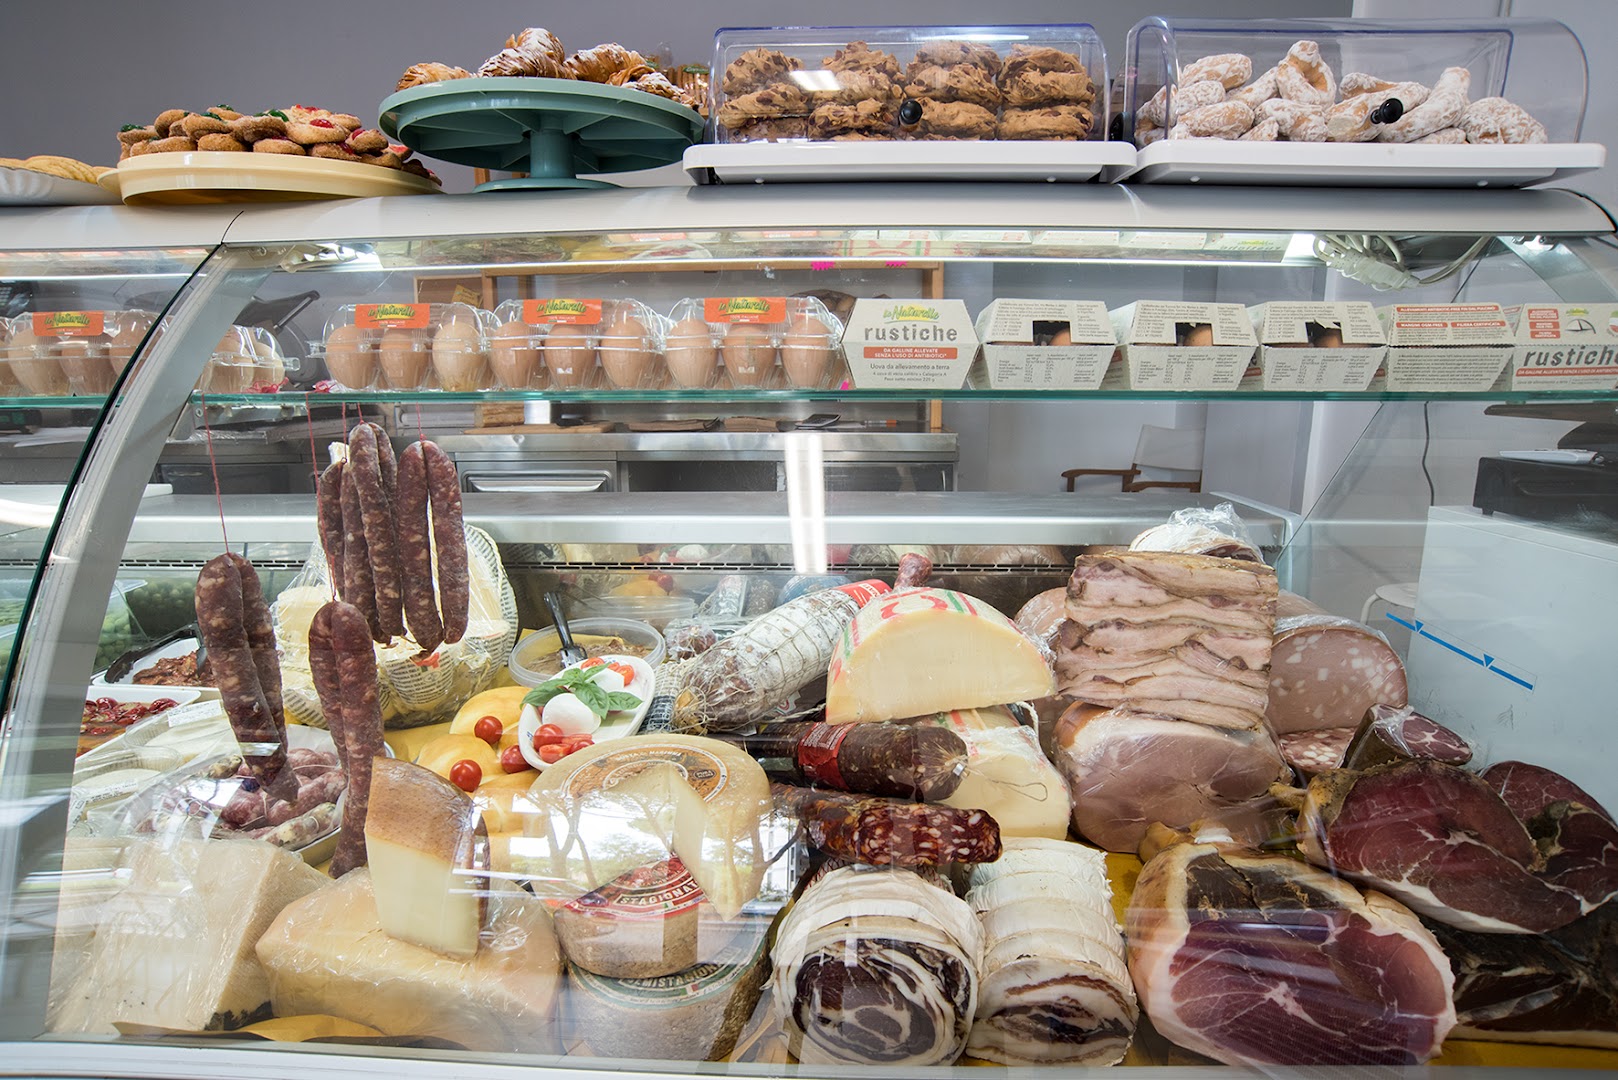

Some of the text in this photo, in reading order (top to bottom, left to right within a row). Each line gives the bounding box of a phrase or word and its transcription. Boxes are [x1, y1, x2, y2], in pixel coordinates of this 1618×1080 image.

[375, 304, 415, 318] Naturelle
[544, 300, 586, 314] Naturelle
[726, 298, 770, 312] Naturelle
[52, 312, 90, 326] Naturelle
[892, 305, 940, 320] Naturelle
[864, 324, 958, 342] rustiche
[620, 881, 698, 905] STAGIONAT
